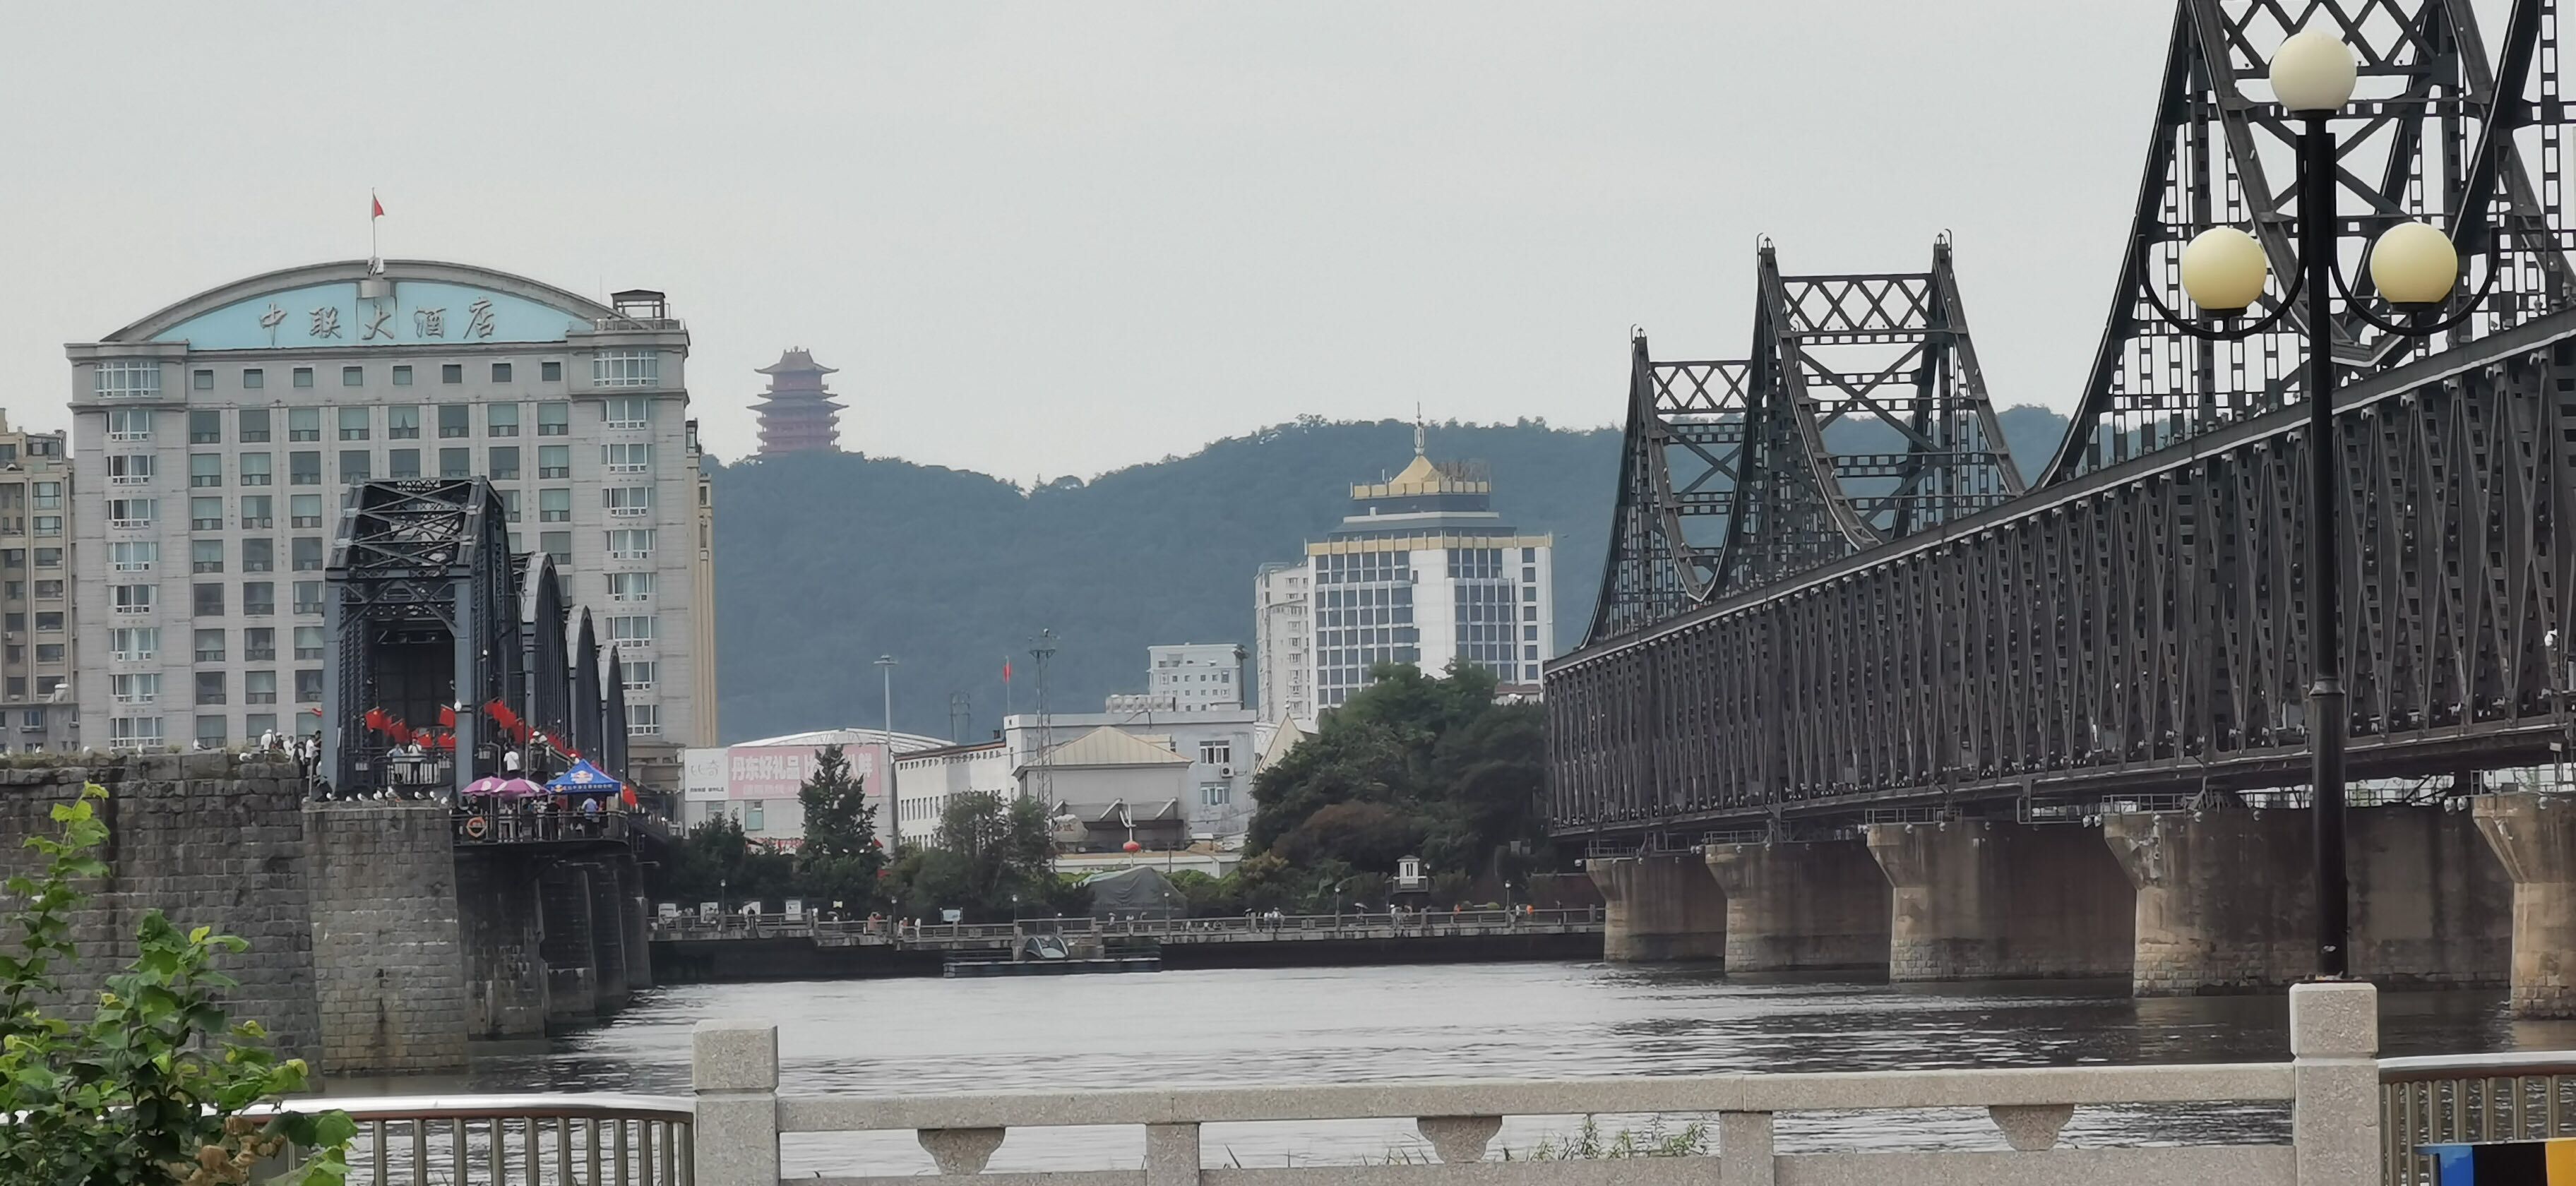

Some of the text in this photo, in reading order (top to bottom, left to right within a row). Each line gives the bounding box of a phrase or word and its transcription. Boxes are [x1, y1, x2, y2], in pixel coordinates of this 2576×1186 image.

[260, 296, 495, 346] 中联大酒店
[732, 755, 801, 780] 丹东好礼品
